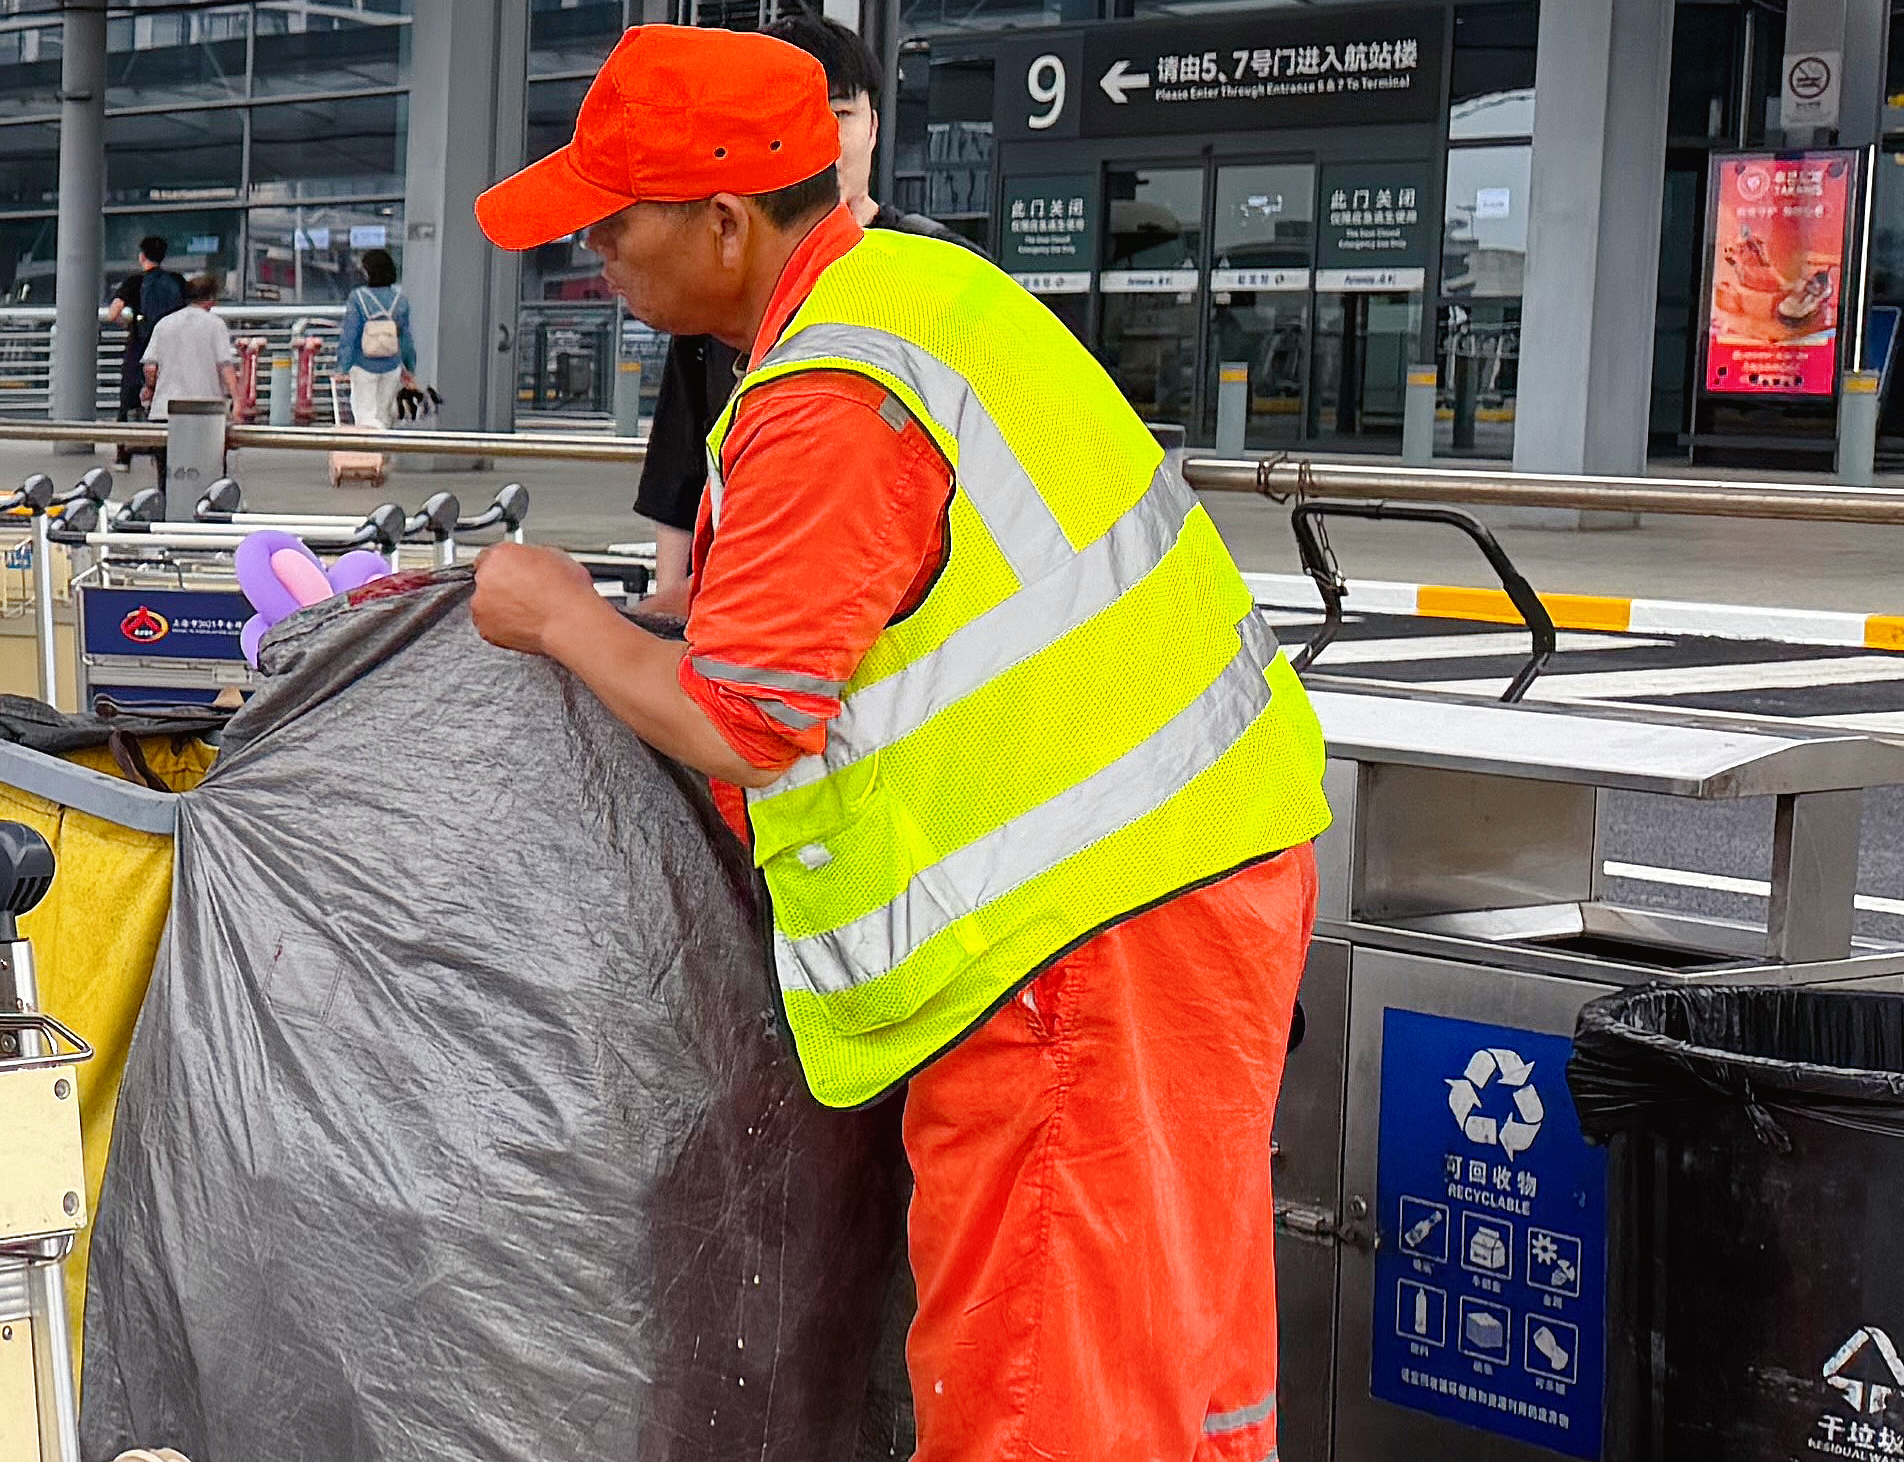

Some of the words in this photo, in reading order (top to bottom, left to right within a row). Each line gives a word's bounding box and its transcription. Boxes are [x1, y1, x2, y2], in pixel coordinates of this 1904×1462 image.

[1157, 38, 1418, 85] 请由5、7号门进入航站楼
[1026, 53, 1067, 129] 9
[1155, 88, 1189, 101] Please
[1221, 84, 1265, 99] Through
[1362, 74, 1410, 89] Terminal
[1444, 1153, 1538, 1198] 可回收物
[1447, 1182, 1532, 1216] RECYCLABLE
